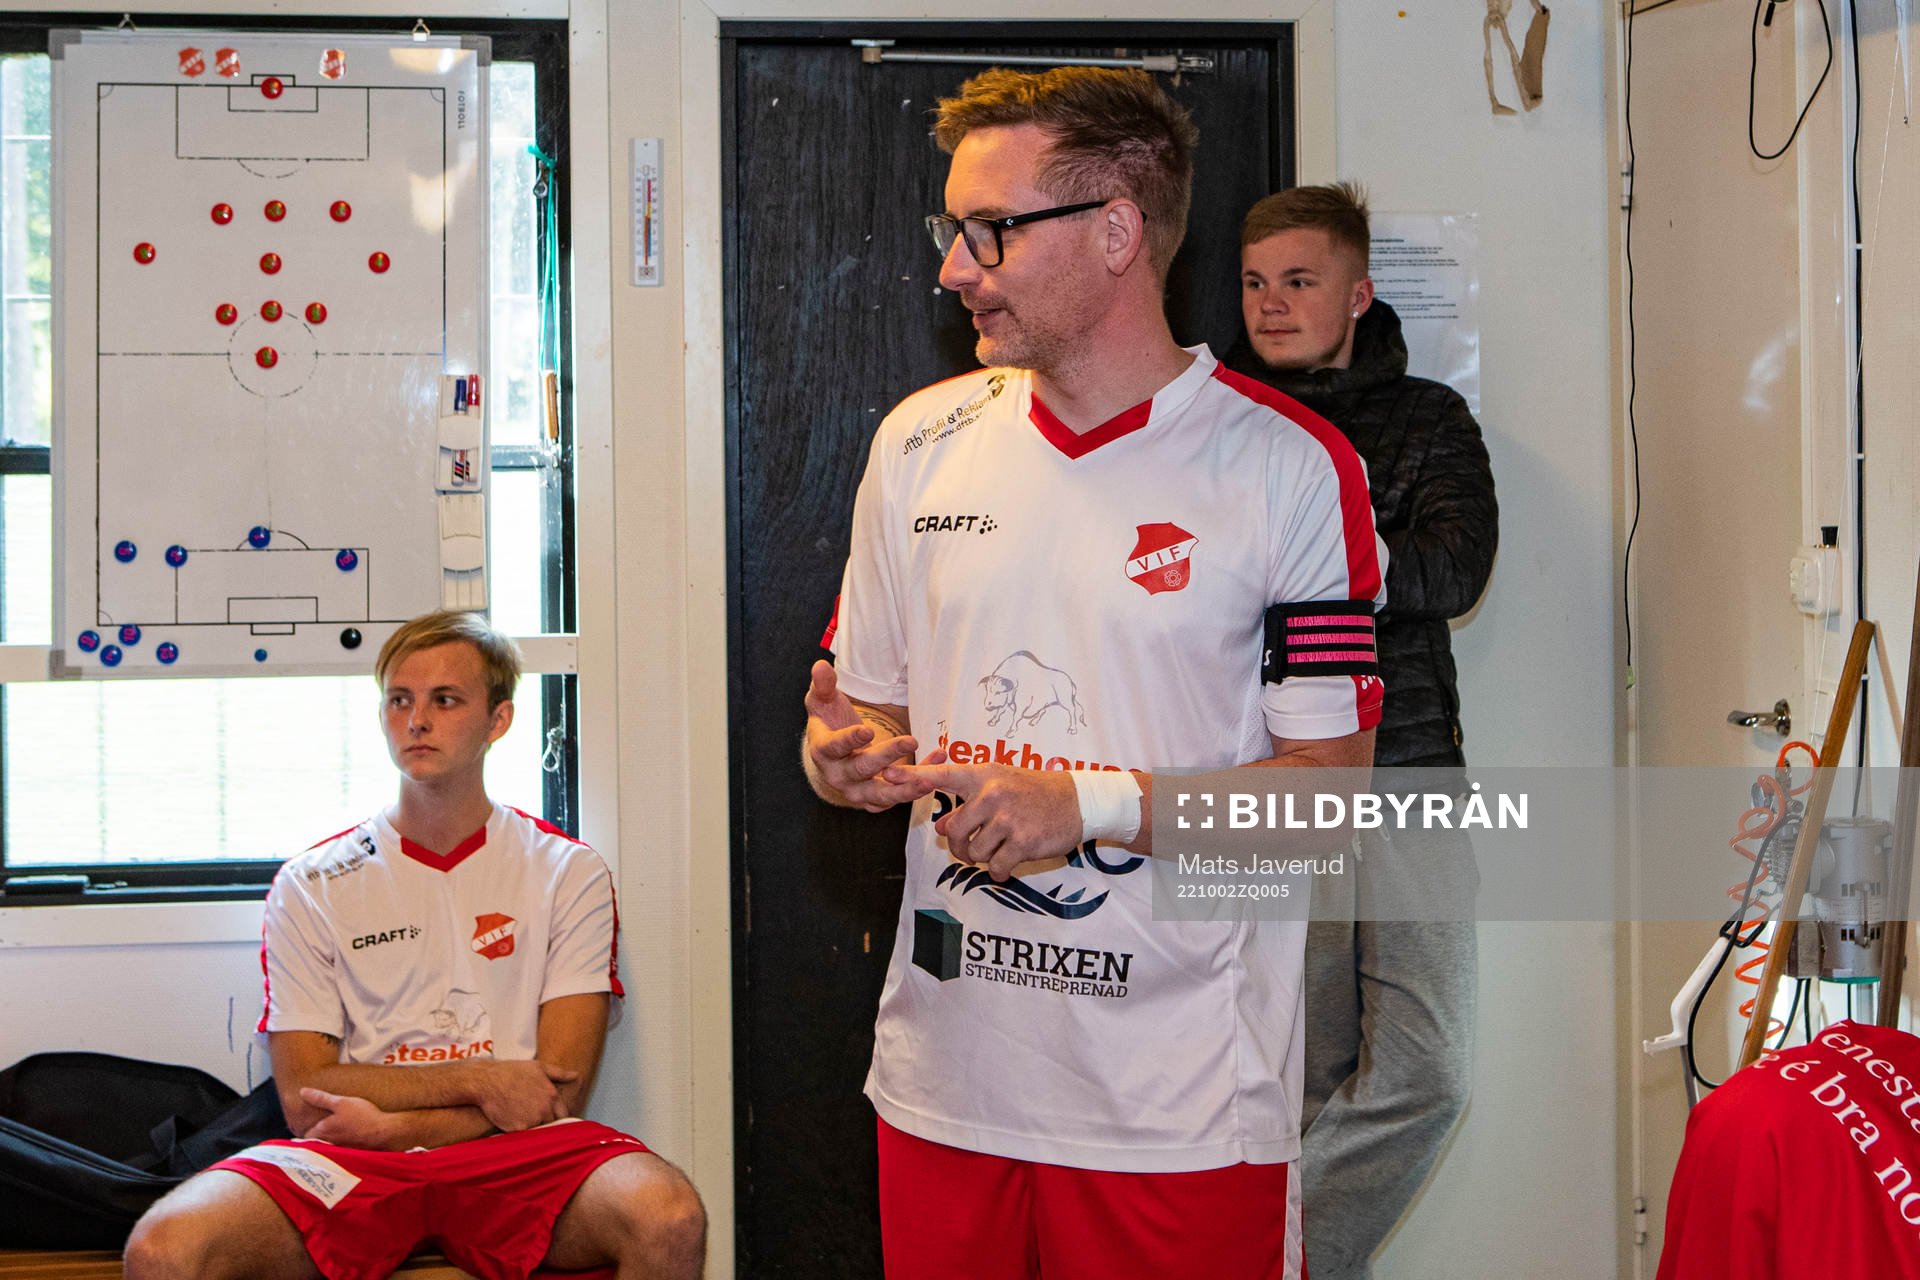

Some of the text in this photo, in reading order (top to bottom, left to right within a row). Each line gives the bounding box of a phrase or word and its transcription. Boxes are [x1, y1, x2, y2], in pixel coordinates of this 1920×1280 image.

[921, 418, 946, 440] Profil
[947, 413, 957, 424] &
[914, 515, 979, 533] CRAFT
[1136, 545, 1180, 571] VIF
[352, 927, 408, 951] CRAFT
[477, 927, 507, 947] VIF
[966, 931, 1134, 983] STRIXEN
[965, 963, 1129, 998] STENENTREPRENAD
[1821, 1022, 1920, 1134] enest
[1809, 1071, 1881, 1155] bra
[1873, 1156, 1920, 1240] no
